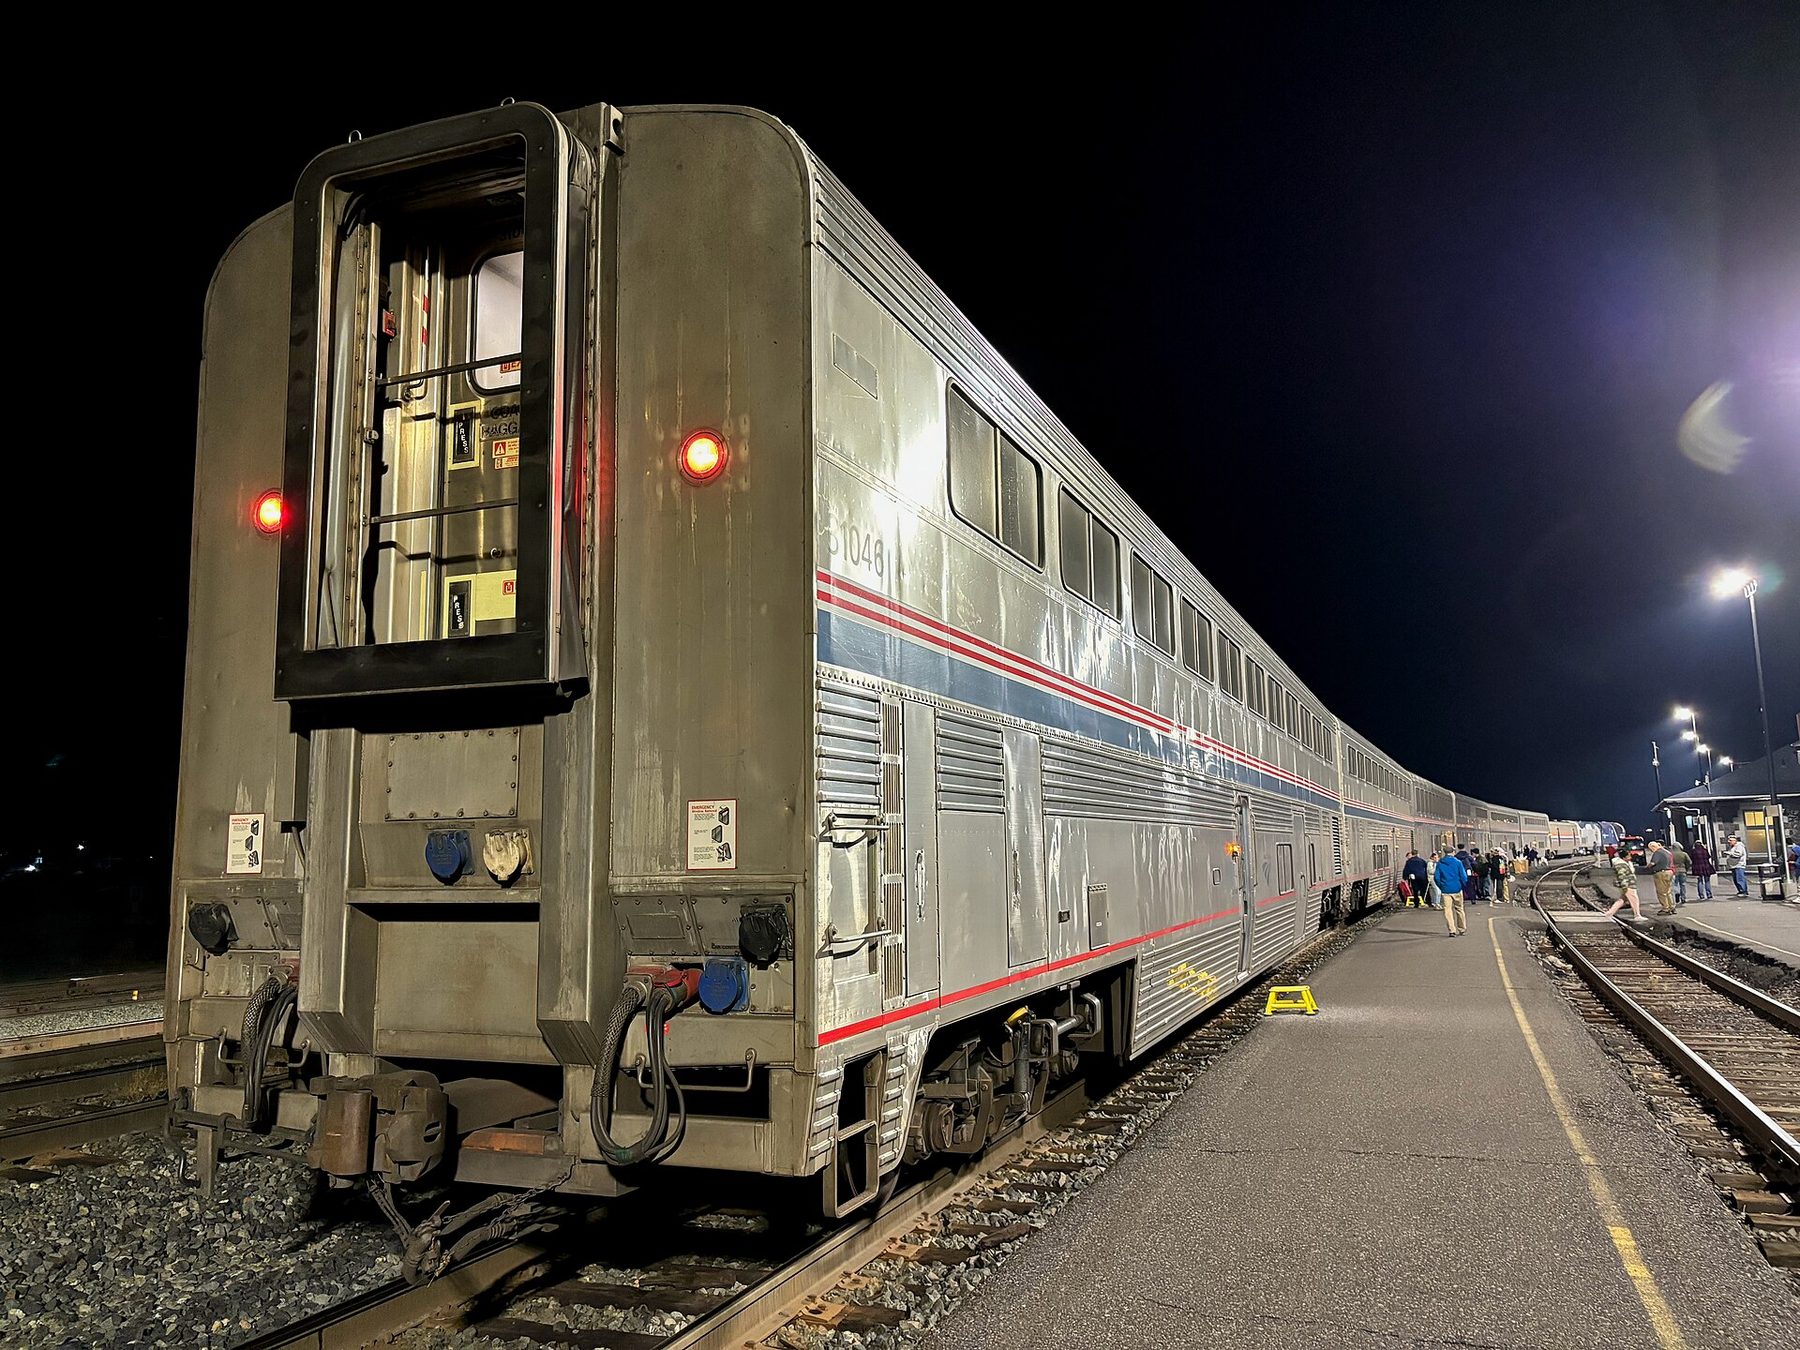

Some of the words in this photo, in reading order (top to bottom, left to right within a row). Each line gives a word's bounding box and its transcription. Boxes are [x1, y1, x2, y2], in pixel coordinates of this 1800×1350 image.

[458, 422, 469, 454] PRESS
[481, 421, 518, 438] BAGG
[453, 595, 464, 629] PRESS
